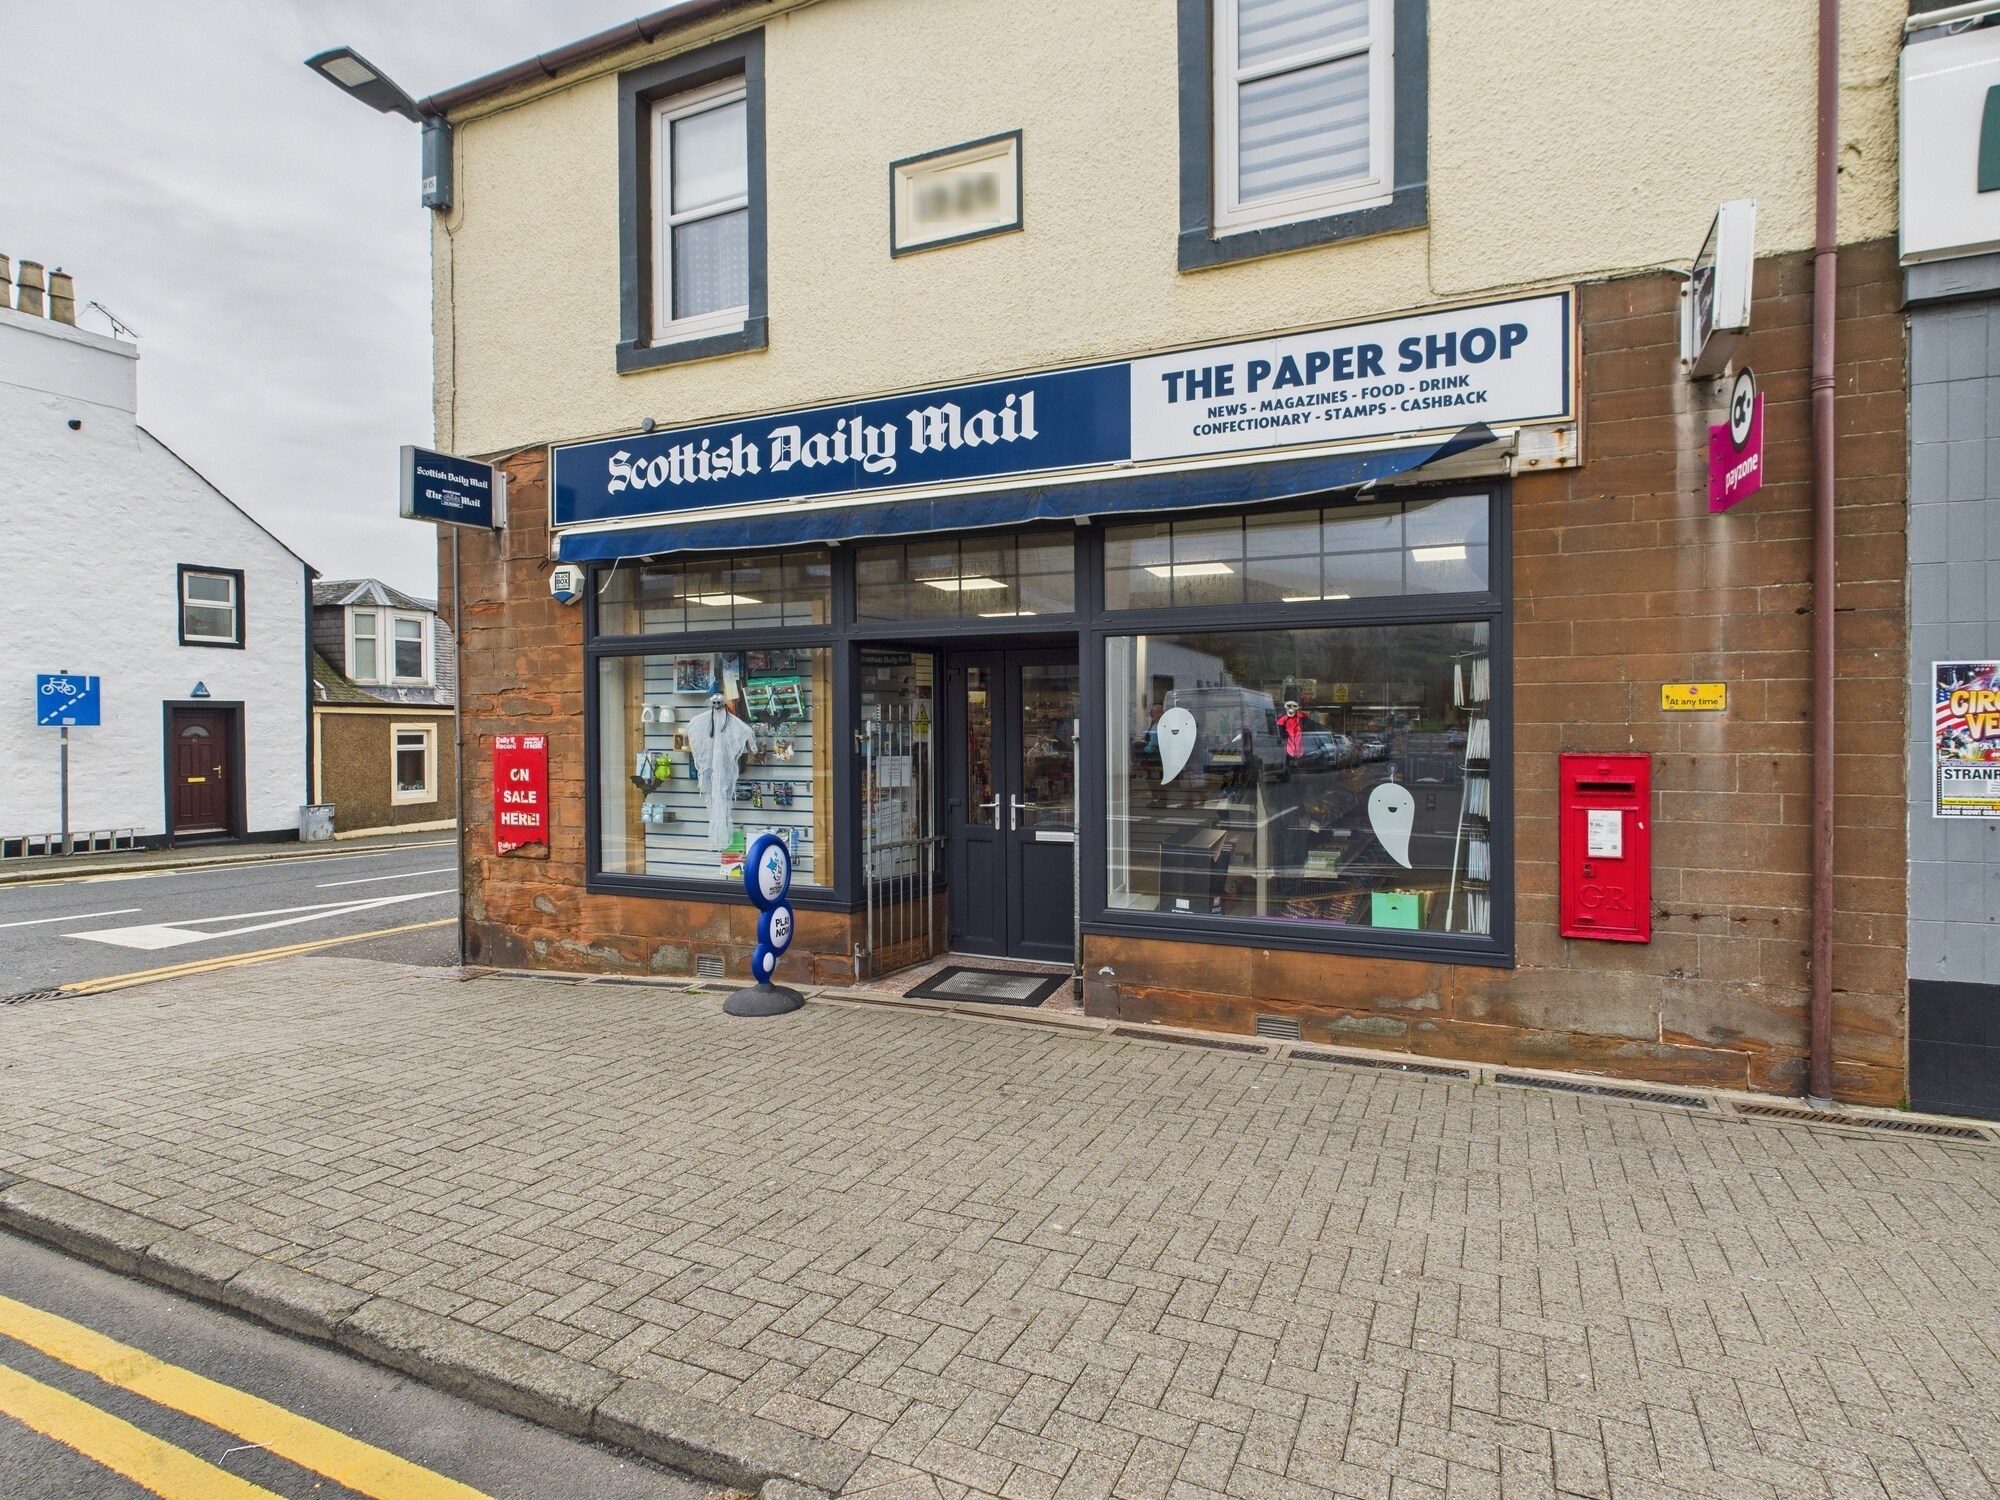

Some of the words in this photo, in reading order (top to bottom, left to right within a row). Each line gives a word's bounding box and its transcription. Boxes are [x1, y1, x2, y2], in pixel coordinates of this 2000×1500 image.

[1161, 363, 1235, 404] THE
[1247, 343, 1386, 393] PAPER
[1398, 322, 1529, 373] SHOP
[1207, 402, 1248, 419] NEWS
[1259, 390, 1348, 413] MAGAZINES
[1361, 382, 1405, 400] FOOD
[1419, 374, 1470, 393] DRINK
[1192, 411, 1311, 437] CONFECTIONARY
[1324, 402, 1387, 422] STAMPS
[1400, 389, 1488, 413] CASHBACK
[607, 432, 762, 495] Scottish
[767, 415, 899, 476] Daily
[906, 390, 1039, 455] Mail
[416, 466, 447, 480] Scottish
[448, 473, 469, 487] Daily
[470, 478, 488, 489] Mail
[1725, 452, 1758, 496] payzone
[425, 489, 442, 500] The
[461, 496, 481, 507] Mail
[1681, 699, 1697, 707] any
[510, 768, 529, 781] ON
[503, 790, 537, 804] SALE
[501, 812, 540, 826] HERE!
[1576, 884, 1632, 911] GR
